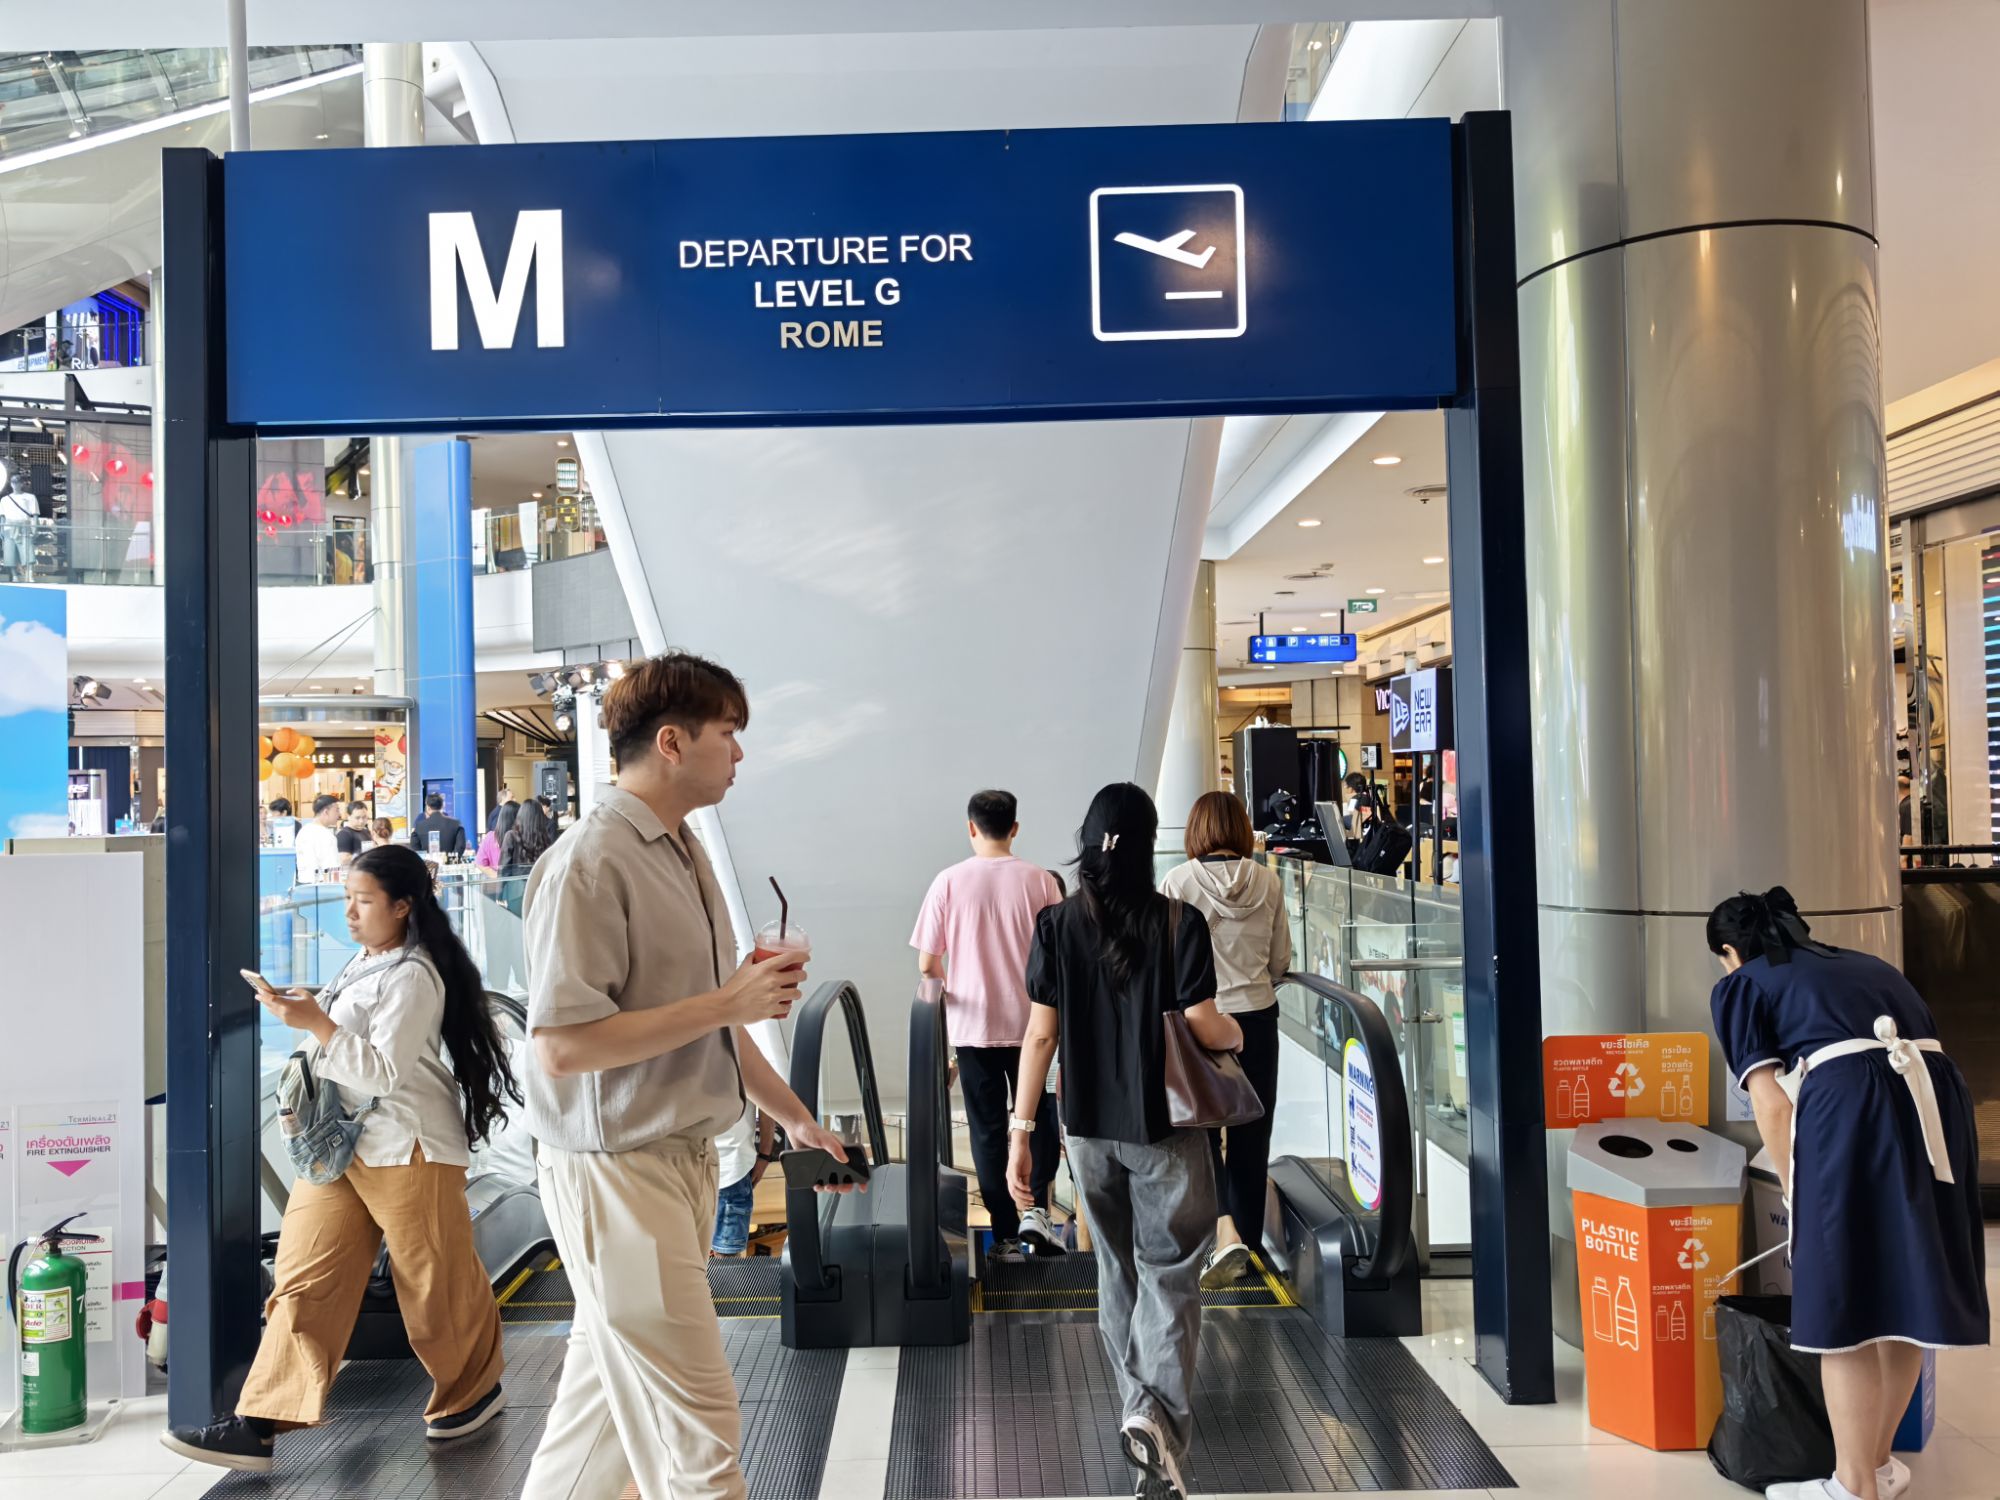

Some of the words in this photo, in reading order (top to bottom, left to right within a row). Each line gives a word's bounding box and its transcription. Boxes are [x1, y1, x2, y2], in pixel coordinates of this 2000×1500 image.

[679, 236, 889, 268] DEPARTURE
[900, 234, 973, 263] FOR
[429, 209, 564, 350] M
[754, 279, 865, 308] LEVEL
[875, 277, 900, 306] G
[780, 320, 883, 349] ROME
[1415, 687, 1432, 711] NEW
[1415, 711, 1432, 733] ERA
[304, 754, 334, 764] LES
[341, 754, 351, 764] &
[1348, 1062, 1374, 1094] WARNING
[26, 1134, 111, 1149] เครื่องดับเพลิง
[26, 1148, 46, 1156] FIRE
[49, 1145, 111, 1155] EXTINGUISHER
[1581, 1218, 1639, 1245] PLASTIC
[1585, 1235, 1638, 1262] BOTTLE
